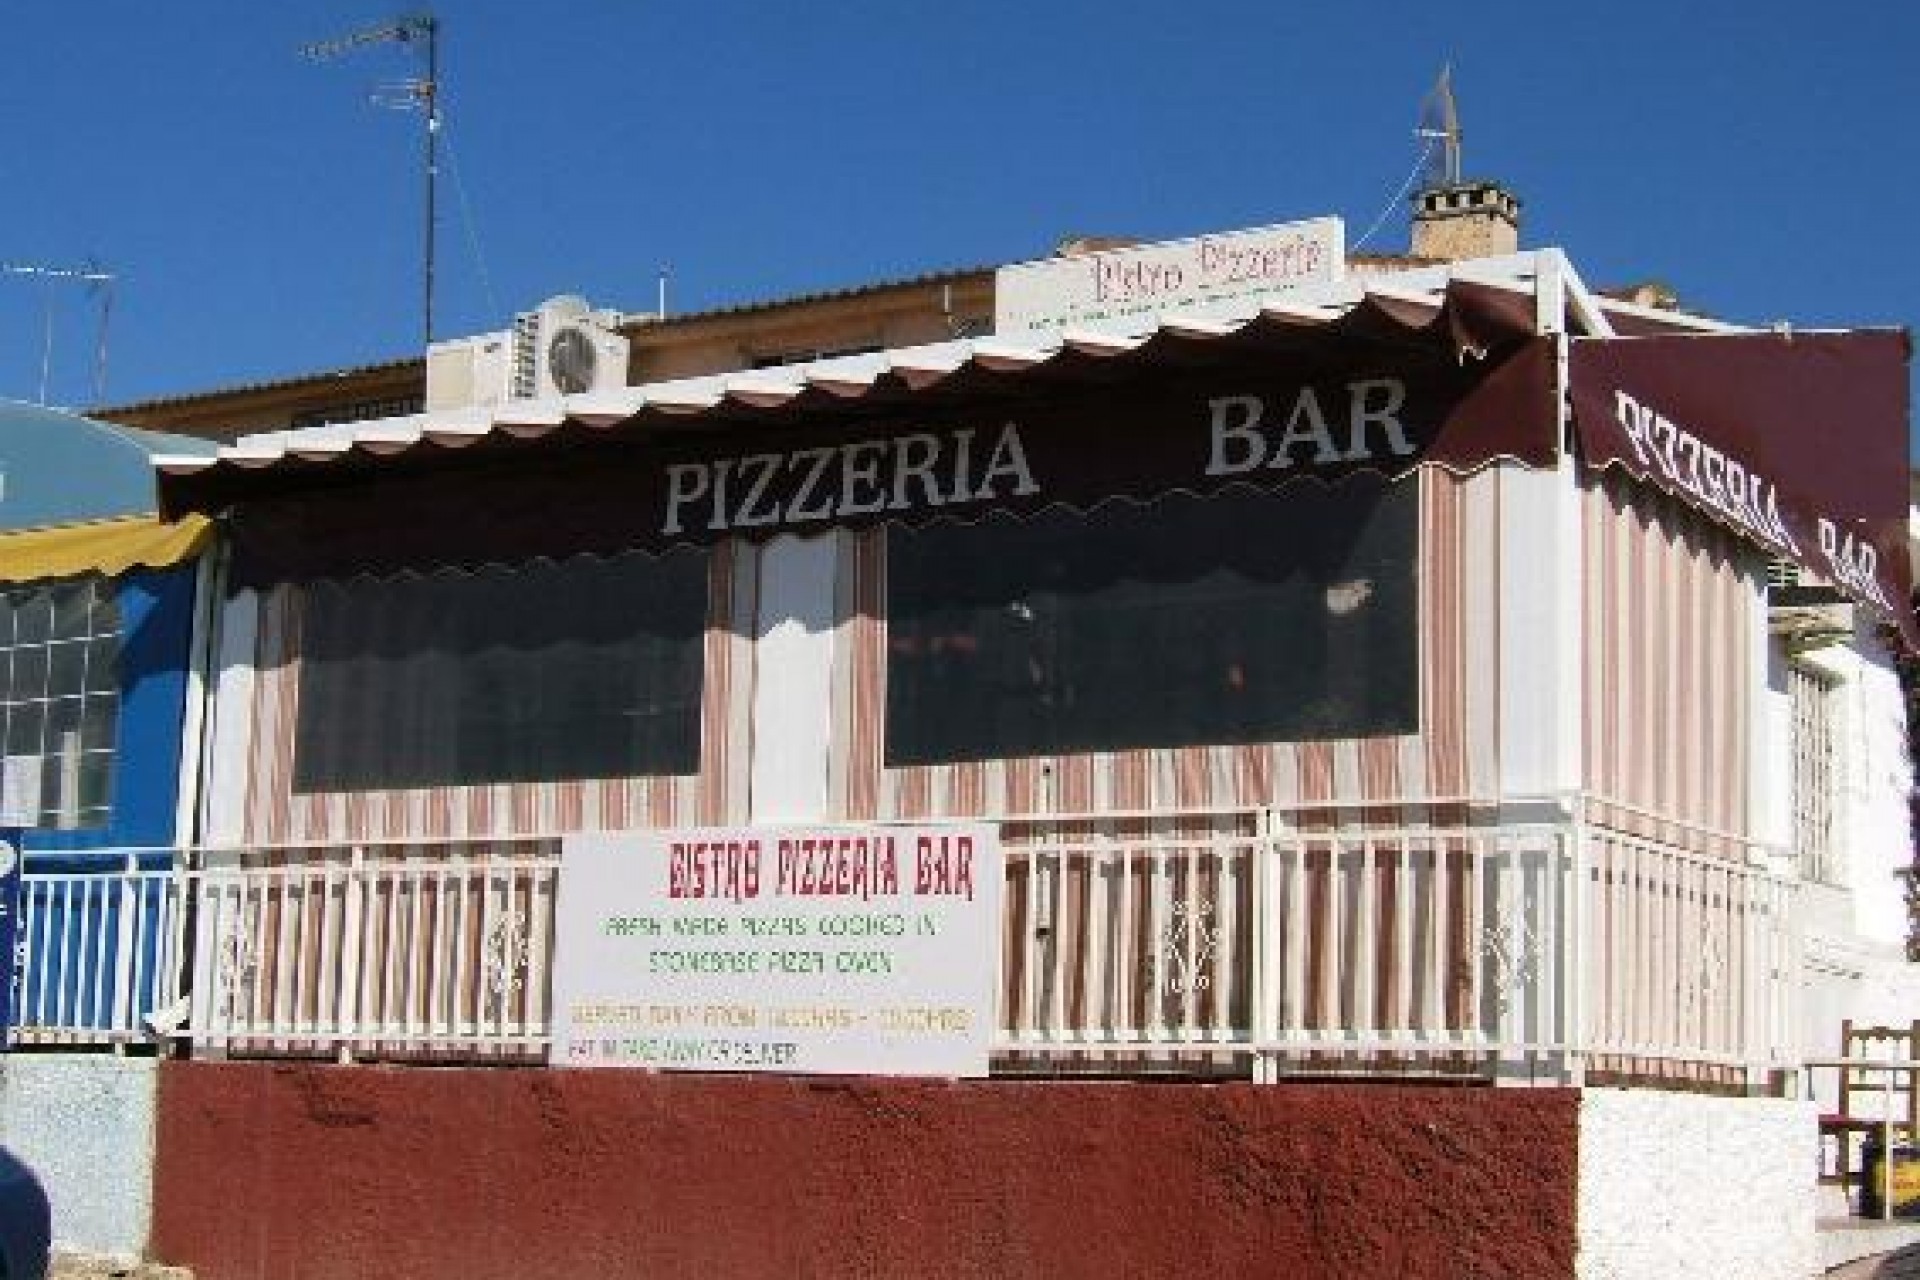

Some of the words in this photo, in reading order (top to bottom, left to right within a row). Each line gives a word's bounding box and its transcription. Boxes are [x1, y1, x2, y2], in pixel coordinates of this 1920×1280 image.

[661, 421, 1041, 536] PIZZERIA
[1203, 378, 1416, 478] BAR
[1614, 389, 1803, 558] PIZZERIA
[1817, 516, 1895, 612] BAR
[669, 839, 761, 903] BISTRO
[774, 836, 899, 901] PIZZERIA
[913, 835, 974, 901] BAR
[741, 917, 807, 936] PIZZAS
[818, 914, 905, 936] COOKED
[767, 951, 824, 973] PIZZA
